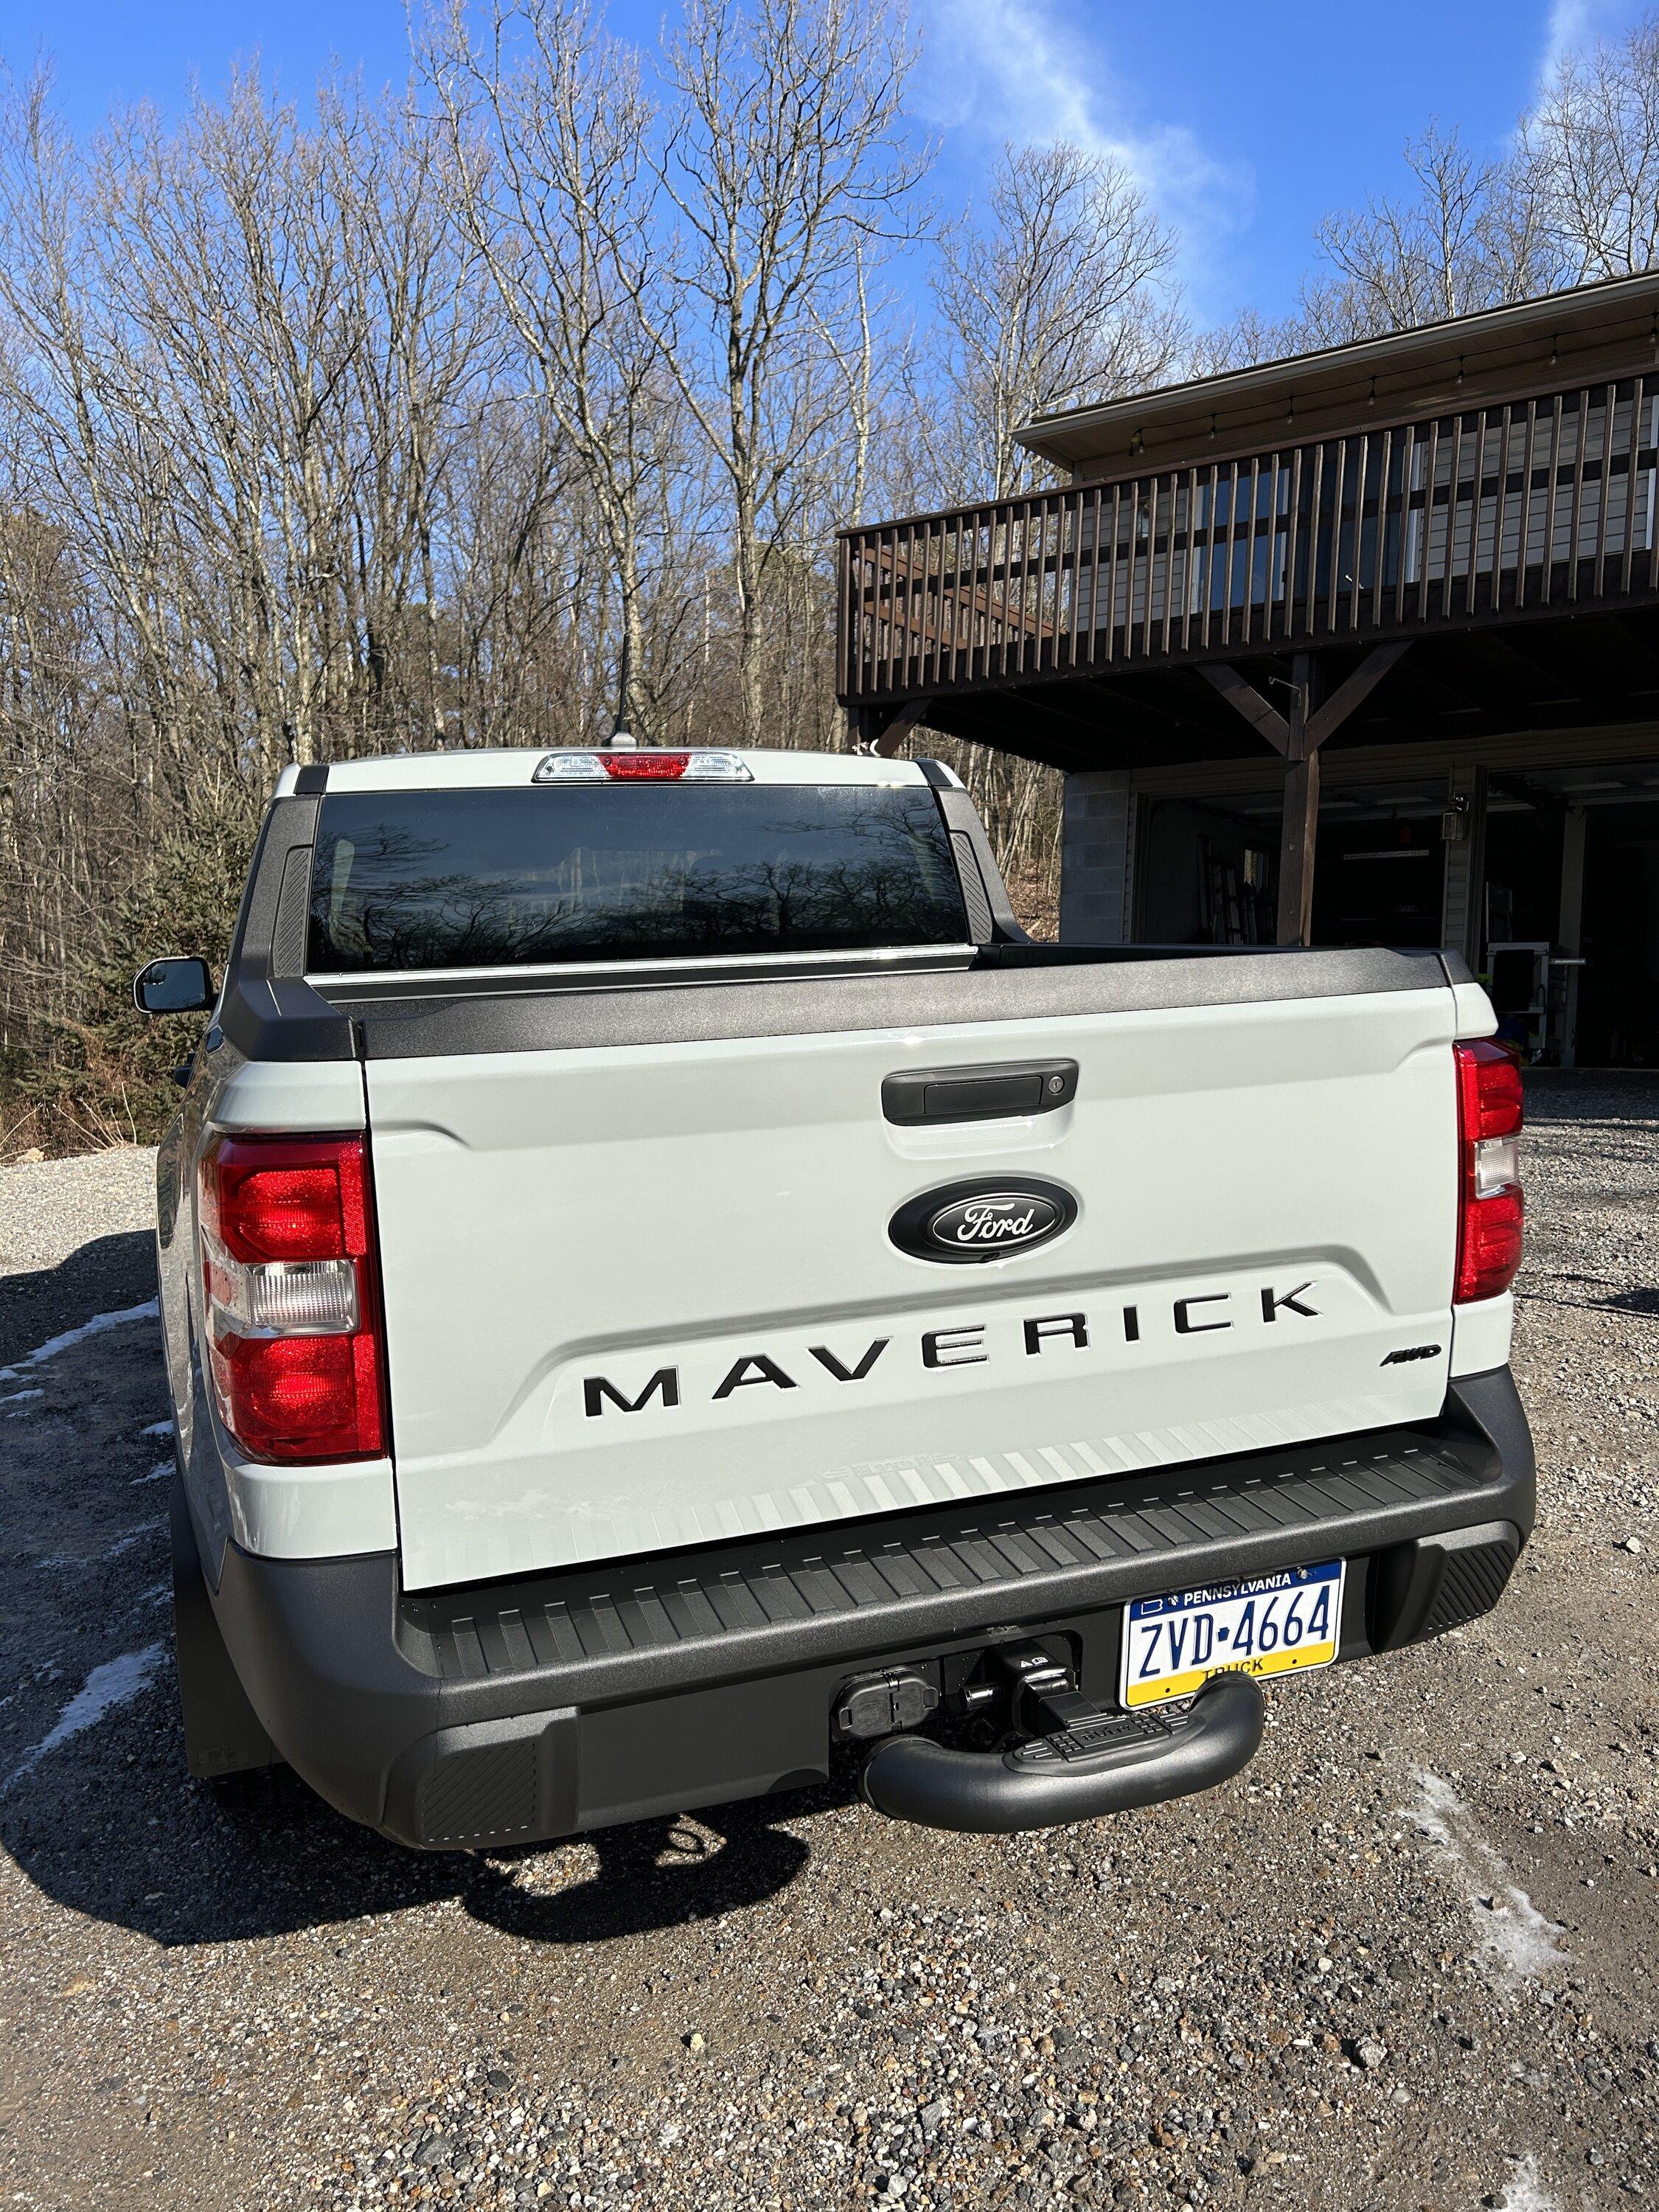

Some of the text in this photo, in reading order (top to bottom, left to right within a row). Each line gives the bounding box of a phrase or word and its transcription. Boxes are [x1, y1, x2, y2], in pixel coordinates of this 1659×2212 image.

[957, 1203, 1034, 1241] Ford
[582, 1281, 1325, 1418] MAVERICK
[1379, 1343, 1442, 1367] AWD
[1184, 1573, 1292, 1607] PENNSYLVANIA
